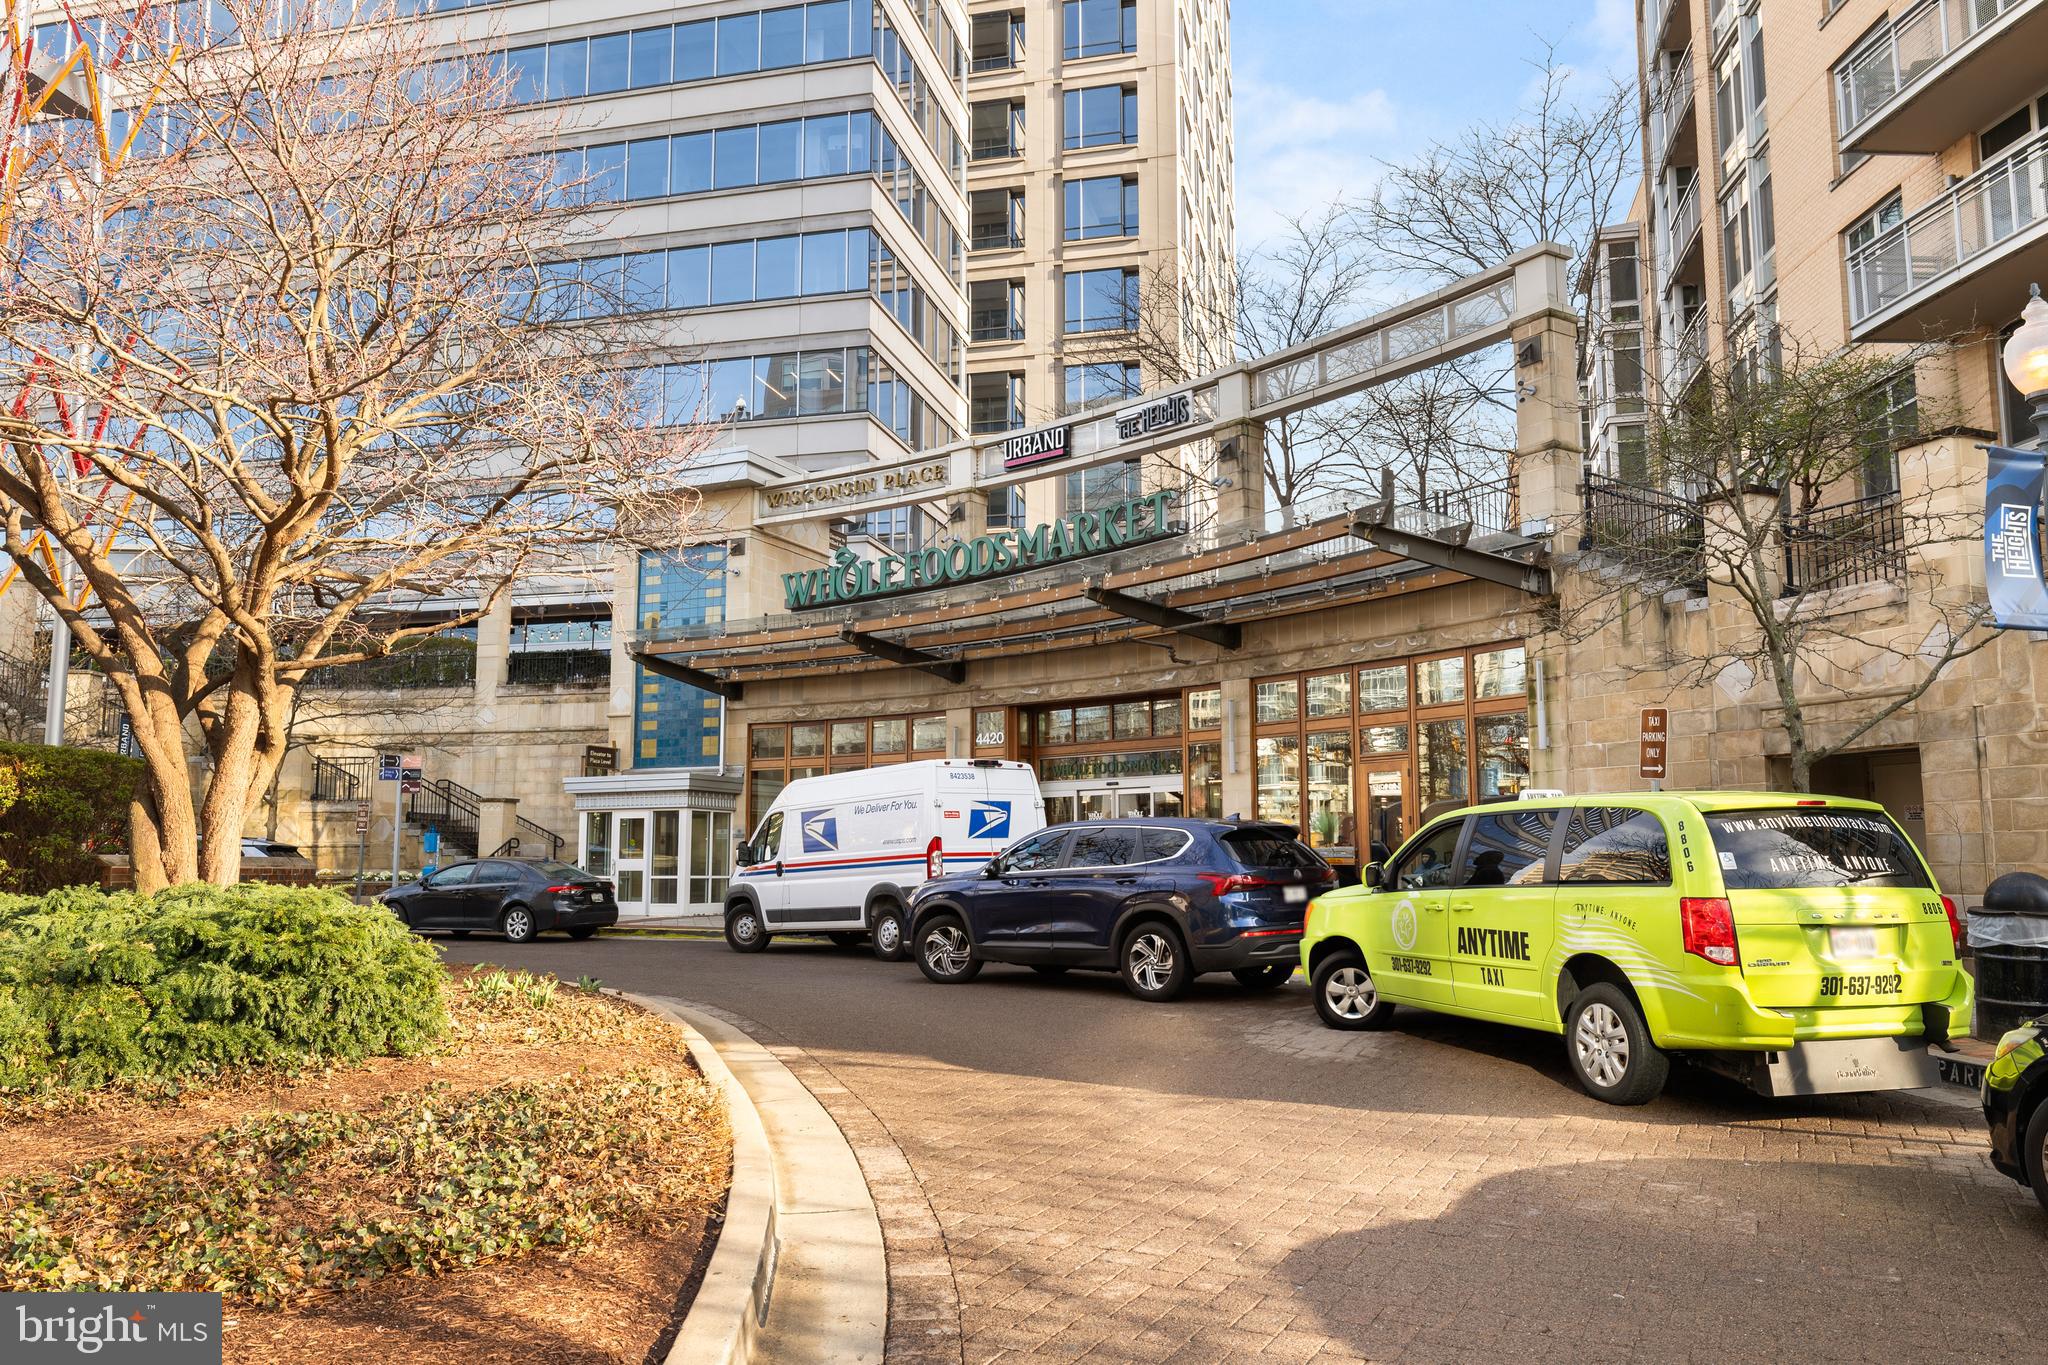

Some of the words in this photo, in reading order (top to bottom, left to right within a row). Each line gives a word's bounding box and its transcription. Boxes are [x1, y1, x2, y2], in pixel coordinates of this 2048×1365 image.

[1116, 418, 1142, 440] THE
[1141, 395, 1189, 433] HEIGHTS
[1003, 427, 1064, 460] URBANO
[767, 477, 877, 509] WISCONSIN
[883, 463, 945, 489] PLACE
[1992, 533, 2005, 562] THE
[2004, 510, 2031, 570] HEIGHTS
[1648, 716, 1660, 727] TAXI
[120, 723, 130, 755] RBANO
[976, 731, 1004, 745] 4420
[1642, 731, 1665, 742] PARKING
[1646, 747, 1660, 758] ONLY
[854, 805, 865, 815] We
[865, 802, 890, 814] Deliver
[890, 801, 903, 811] For
[903, 799, 918, 810] You.
[1720, 814, 1893, 835] www.anytimeuniontaxi.com
[1678, 820, 1694, 873] 8806
[1843, 855, 1895, 873] ANYONE.
[1922, 902, 1943, 915] 8806
[1610, 910, 1638, 933] ANYONE.
[1457, 926, 1531, 961] ANYTIME
[1391, 956, 1432, 976] 301-637-9292
[1480, 967, 1505, 987] TAXI
[1820, 974, 1902, 996] 301-637-9292
